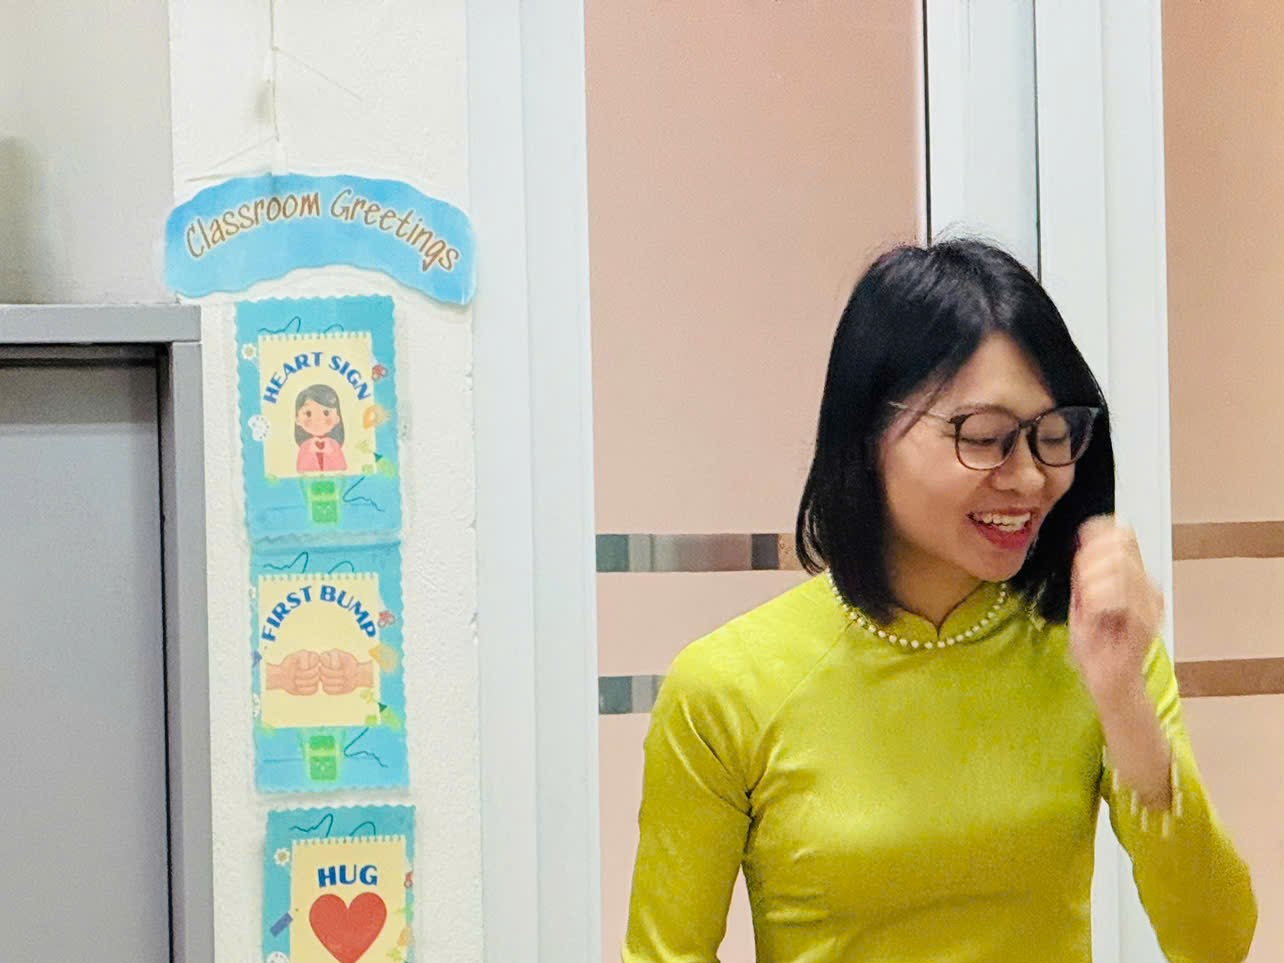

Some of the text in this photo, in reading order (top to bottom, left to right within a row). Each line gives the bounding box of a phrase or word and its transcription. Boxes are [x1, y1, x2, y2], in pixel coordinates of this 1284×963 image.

[185, 189, 460, 272] Classroom Greetings
[262, 352, 372, 405] HEART SIGN
[261, 584, 377, 643] FIRST BUMP
[317, 864, 378, 888] HUG
